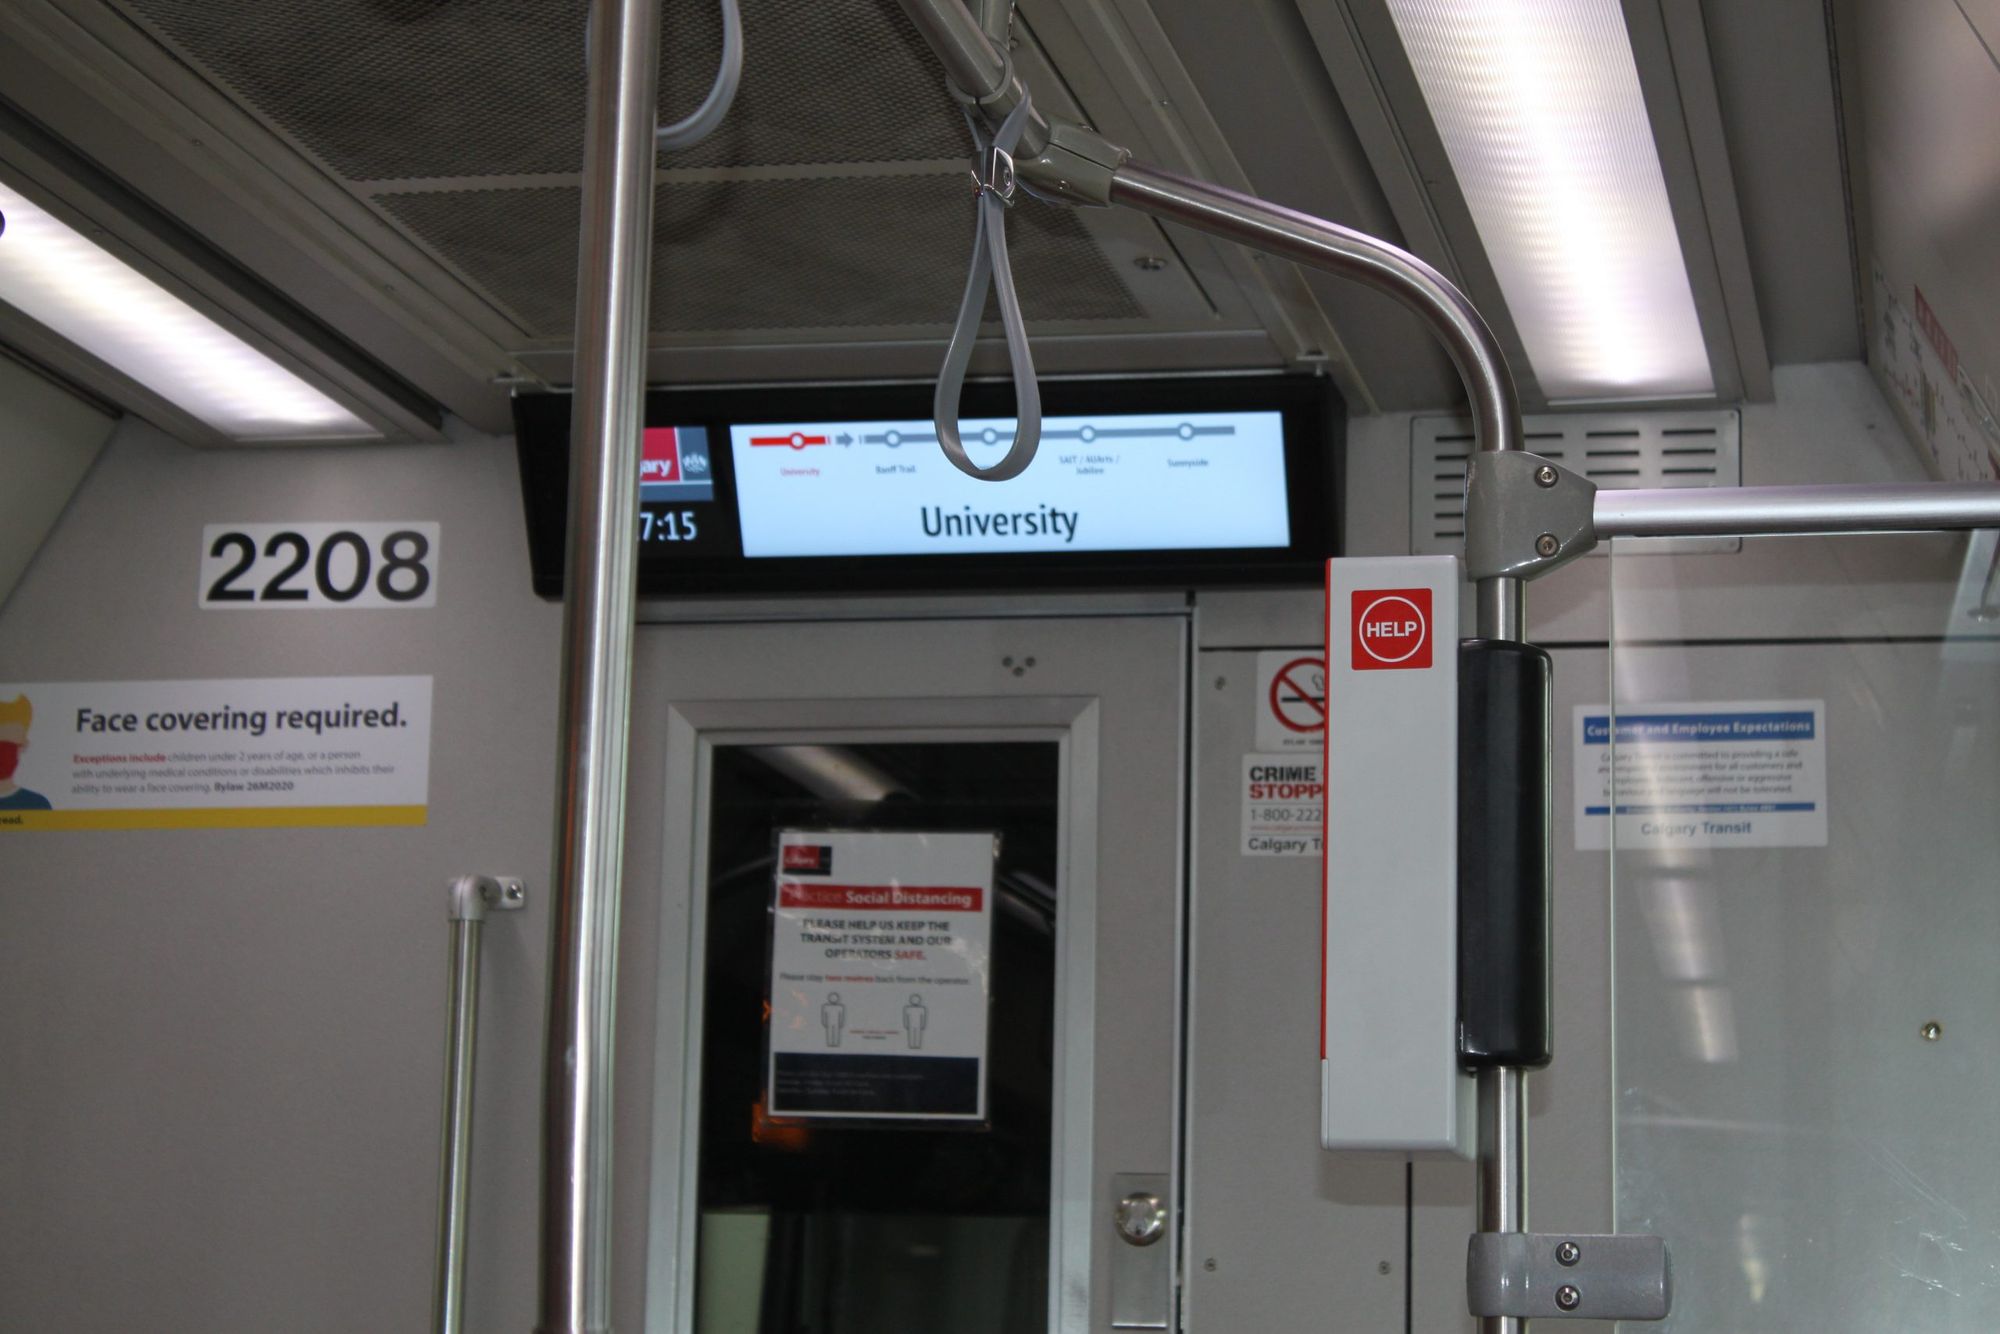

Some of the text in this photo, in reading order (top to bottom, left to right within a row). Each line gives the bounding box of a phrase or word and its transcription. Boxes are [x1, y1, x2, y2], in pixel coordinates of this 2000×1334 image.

[639, 458, 672, 476] ary
[875, 464, 917, 474] Banff Trail
[1167, 458, 1209, 469] Sunnyside
[780, 467, 820, 477] University
[920, 504, 1079, 542] University
[206, 531, 430, 602] 2208
[1366, 621, 1417, 637] HELP
[75, 702, 407, 736] Face covering required.
[1646, 723, 1669, 734] and
[1672, 722, 1730, 737] Employee
[1733, 721, 1811, 735] Expectations
[73, 754, 126, 765] Exceptions
[129, 753, 166, 763] include
[167, 753, 206, 762] children
[208, 752, 236, 761] under
[246, 753, 272, 763] years
[273, 751, 284, 760] of
[327, 752, 361, 762] person
[72, 764, 394, 779] with underlying medical conditions or disabilities which inhibits their
[1249, 766, 1317, 782] CRIME
[72, 784, 99, 794] ability
[102, 784, 113, 793] to
[114, 785, 137, 793] wear
[147, 783, 167, 792] face
[214, 782, 244, 793] Bylaw
[1249, 783, 1324, 799] STOPP
[1250, 808, 1322, 822] 1-800-222
[1641, 821, 1752, 837] Calgary Transit
[1248, 837, 1307, 853] Calgary
[846, 890, 889, 905] Social
[893, 891, 972, 908] Distancing
[802, 918, 949, 931] PLEASE HELP US KEEP THE
[800, 933, 952, 946] TRANSIT SYSTEM AND OUR
